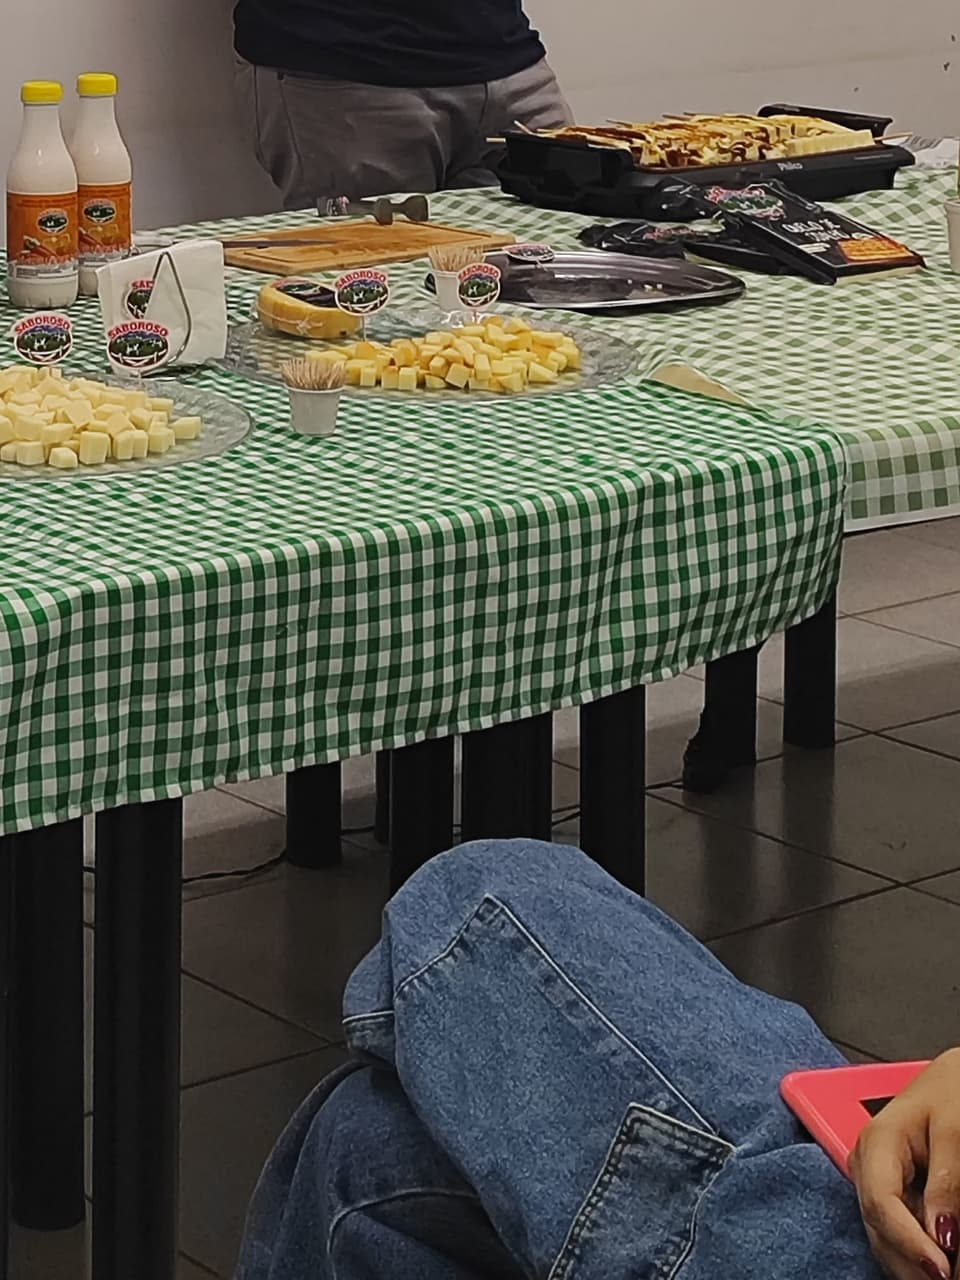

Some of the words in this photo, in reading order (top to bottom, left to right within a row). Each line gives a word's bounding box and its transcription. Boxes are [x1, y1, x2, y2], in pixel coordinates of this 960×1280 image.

[335, 270, 387, 289] SABOROSO
[15, 316, 71, 334] SABOROSO
[107, 322, 169, 338] SABOROSO
